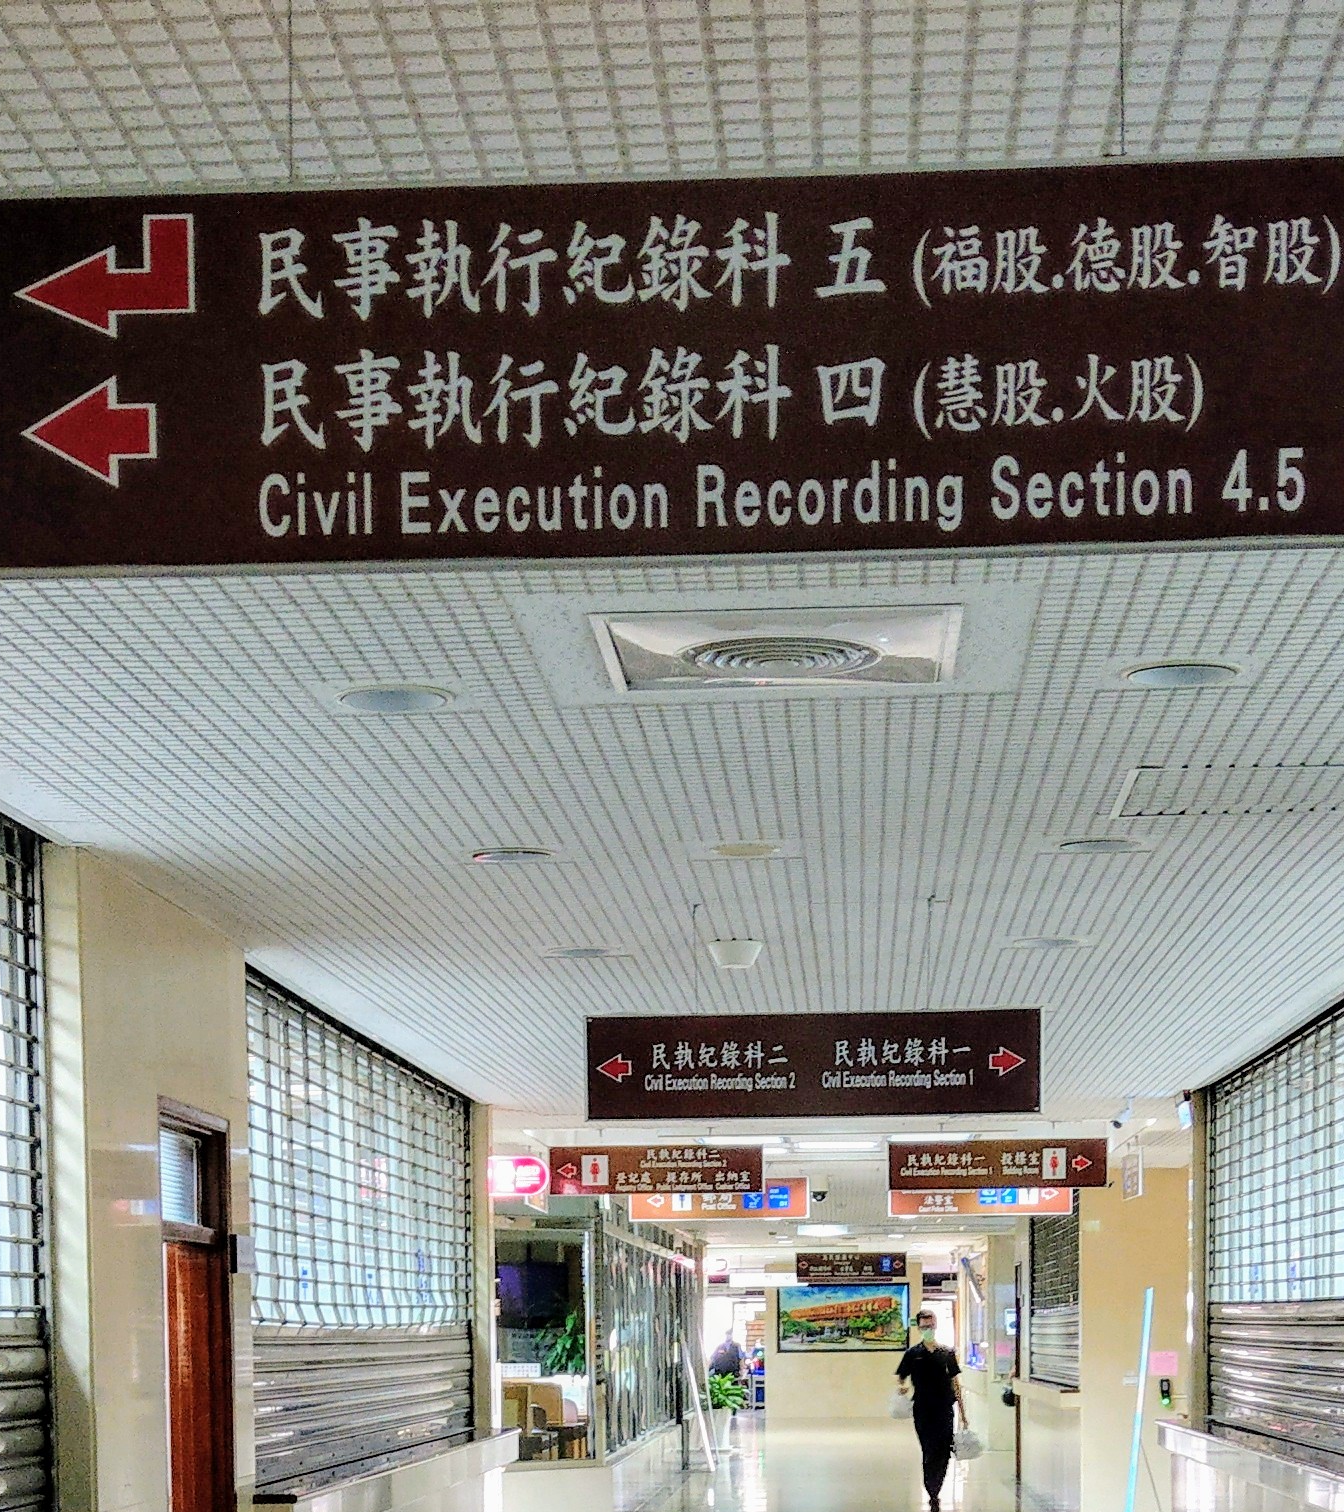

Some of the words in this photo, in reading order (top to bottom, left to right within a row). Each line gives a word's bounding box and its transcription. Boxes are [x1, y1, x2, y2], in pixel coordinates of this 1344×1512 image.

[258, 215, 792, 321] 民事執行紀錄科
[815, 216, 887, 298] 五
[258, 347, 792, 453] 民事執行紀錄科
[815, 356, 886, 427] 四
[258, 471, 374, 539] Civil
[400, 465, 669, 534] Execution
[696, 458, 964, 538] Recording
[990, 451, 1193, 520] Section
[1221, 447, 1307, 512] 4.5
[652, 1041, 789, 1070] 民執紀錄科二
[834, 1037, 972, 1067] 民執紀錄科一
[644, 1074, 664, 1091] Civil
[665, 1073, 708, 1090] Execution
[710, 1073, 753, 1092] Recording
[755, 1072, 787, 1089] Section
[788, 1072, 796, 1089] 2
[821, 1071, 841, 1088] Civil
[843, 1070, 887, 1088] Execution
[888, 1069, 932, 1088] Recording
[933, 1069, 967, 1086] Section
[968, 1068, 974, 1086] 1
